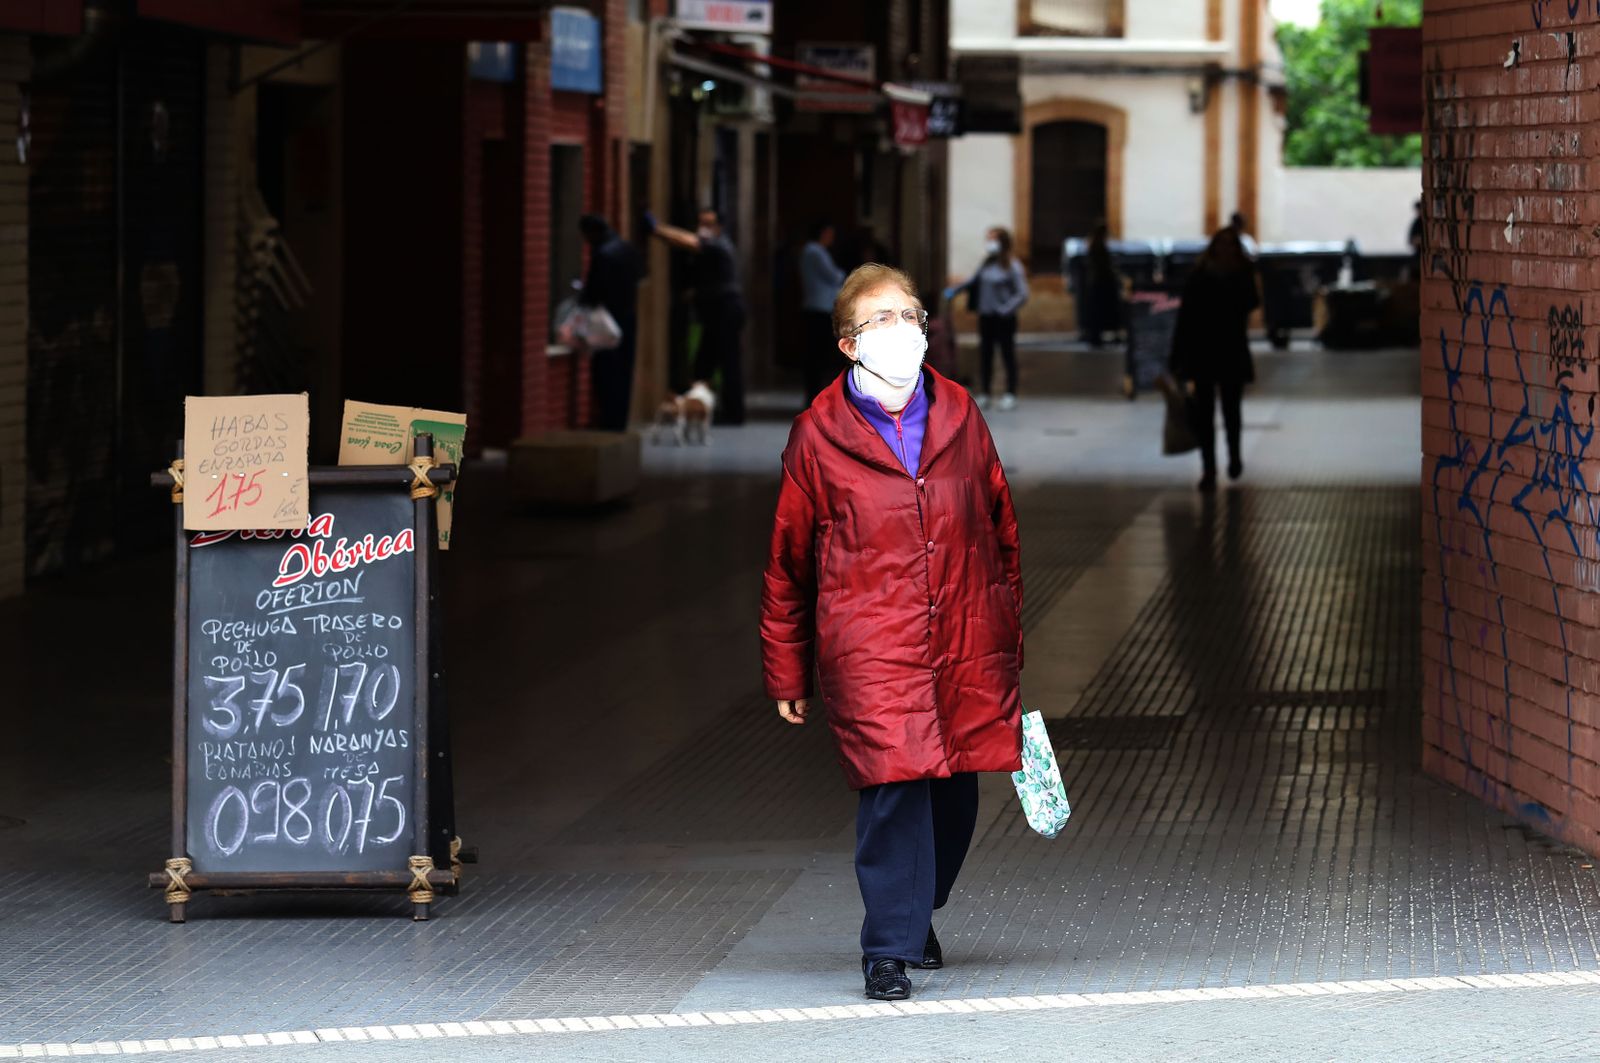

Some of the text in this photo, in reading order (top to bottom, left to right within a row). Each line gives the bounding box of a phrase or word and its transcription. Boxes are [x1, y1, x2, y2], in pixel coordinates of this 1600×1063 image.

[211, 412, 289, 440] HABAS
[213, 435, 287, 456] GORDAS
[374, 441, 402, 454] Cosa
[255, 570, 365, 610] OFERTON
[201, 615, 297, 644] PECHUGA
[303, 613, 402, 635] TRASERO
[233, 639, 256, 654] DE
[345, 631, 367, 644] DE
[211, 650, 277, 675] POLLO
[322, 643, 389, 662] POLLO
[343, 751, 368, 763] DE
[205, 760, 292, 781] CANARIAS
[323, 761, 379, 779] MESA
